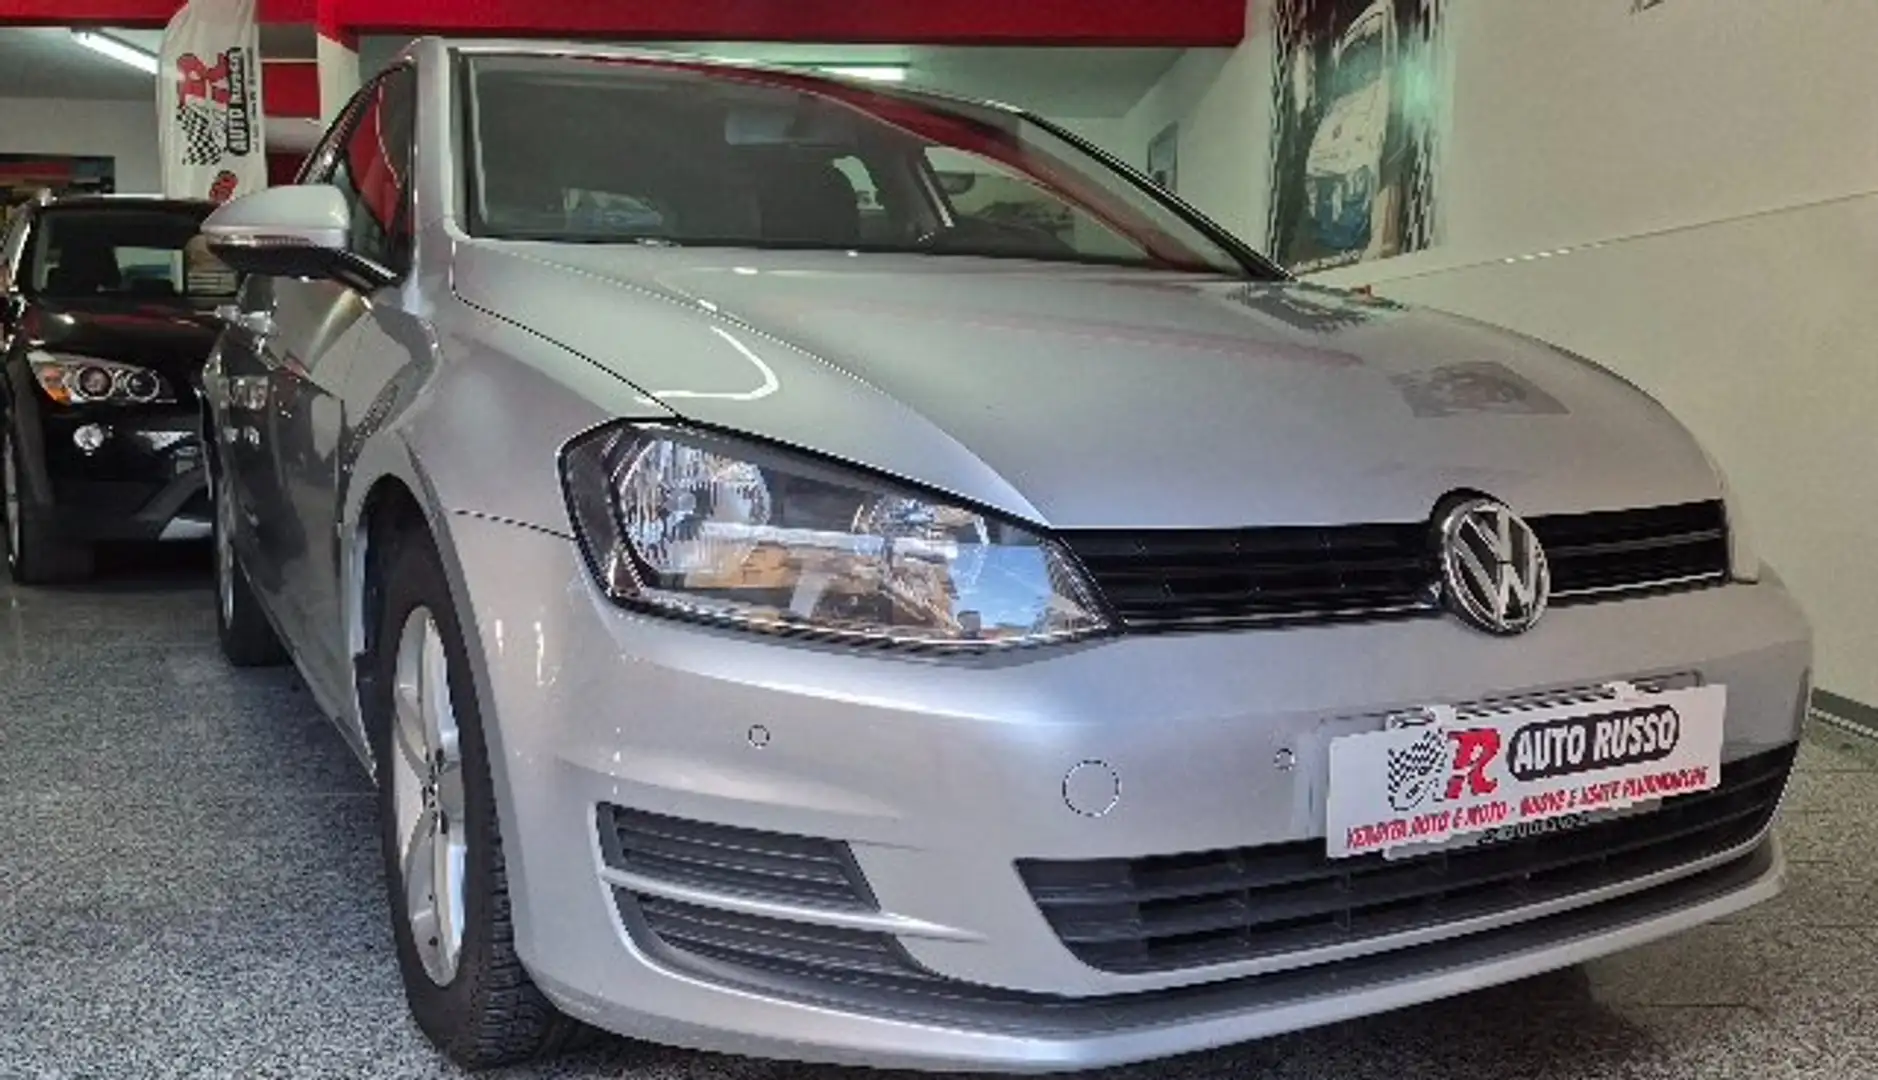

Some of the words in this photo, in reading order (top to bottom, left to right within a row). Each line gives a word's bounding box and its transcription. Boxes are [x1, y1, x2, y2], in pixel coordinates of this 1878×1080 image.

[228, 108, 248, 151] AUTO
[1513, 724, 1587, 774] AUTO
[1593, 709, 1677, 762] RUSSO
[1409, 810, 1450, 838] AUTO
[1464, 801, 1507, 827] MOTO
